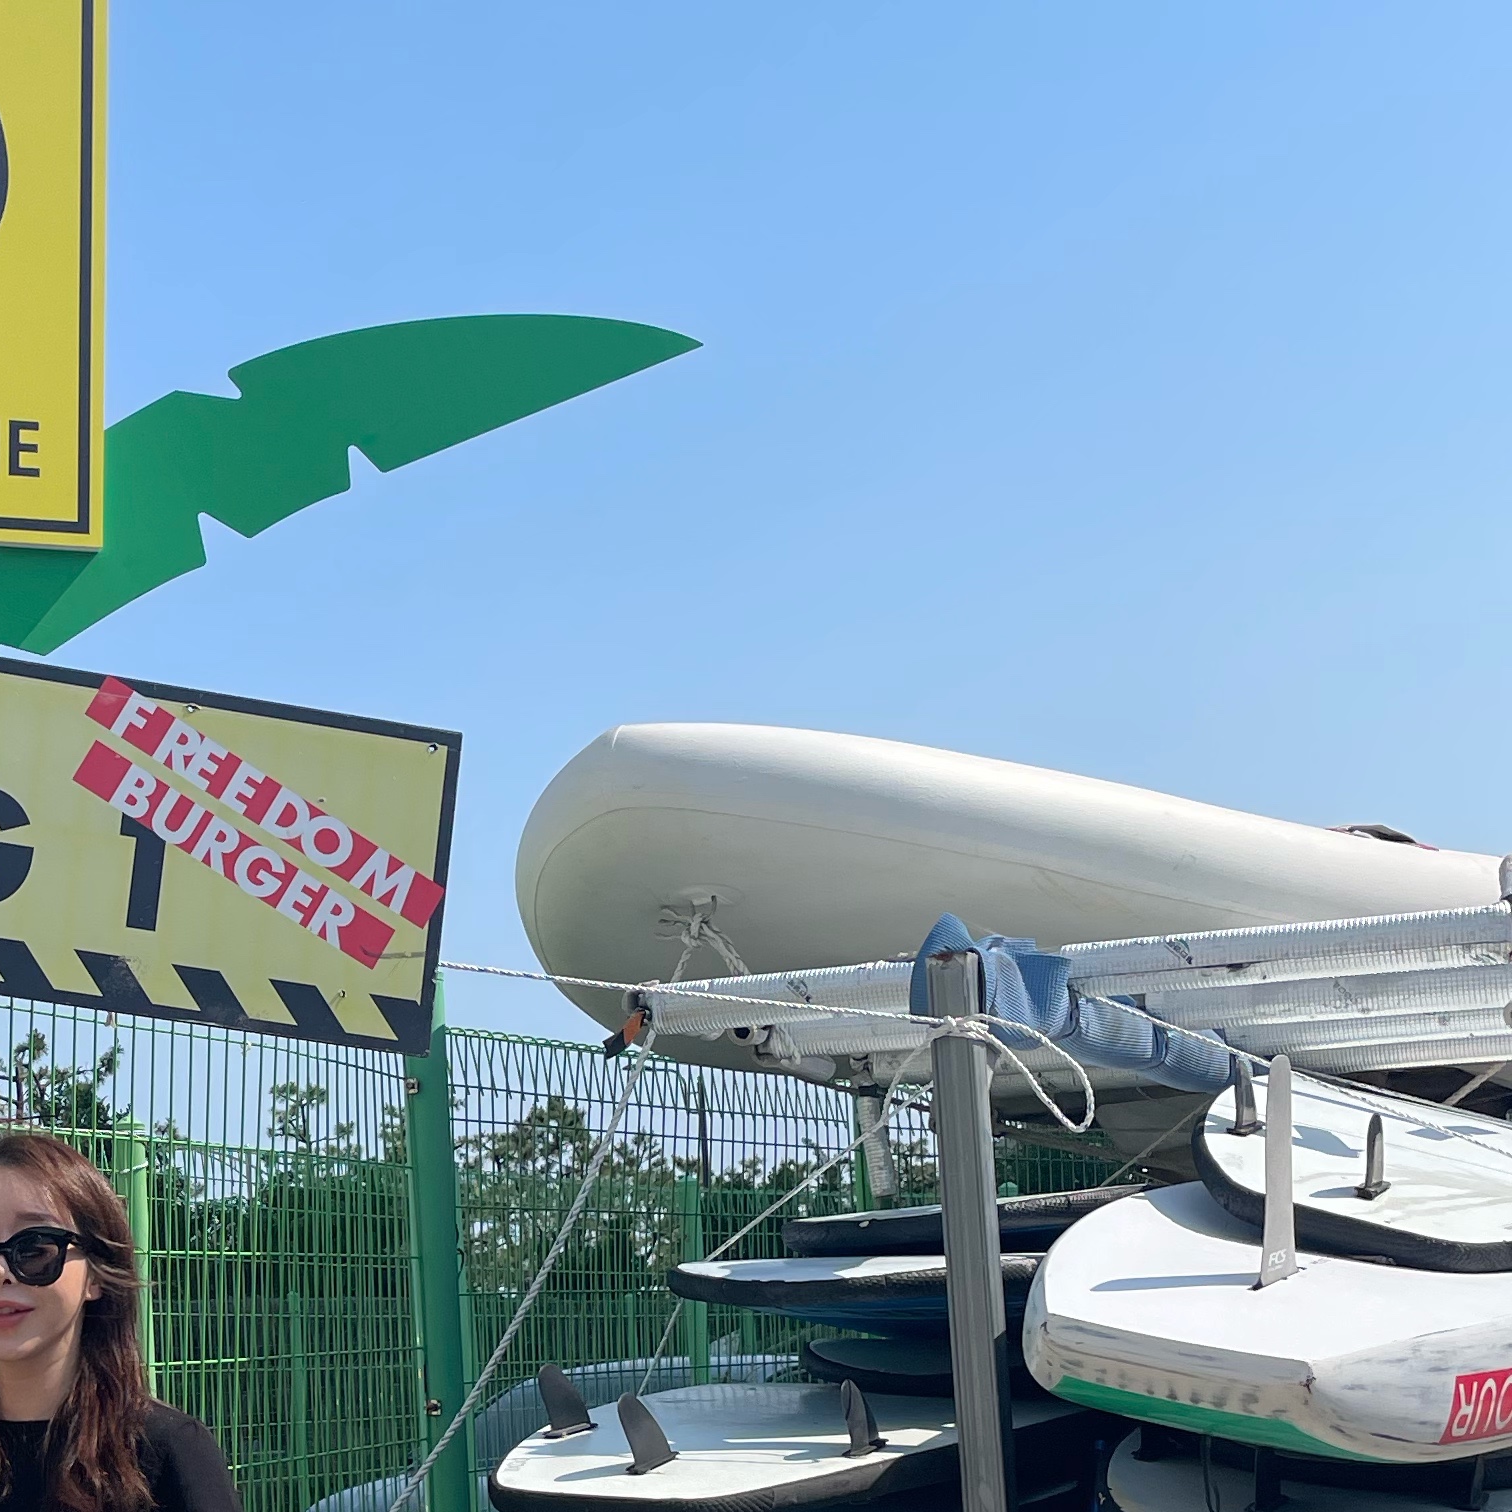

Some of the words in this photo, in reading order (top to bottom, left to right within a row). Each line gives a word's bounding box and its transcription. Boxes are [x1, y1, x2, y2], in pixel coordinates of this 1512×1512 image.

[108, 761, 356, 951] BURGER
[109, 690, 416, 915] FREEDOM
[119, 811, 167, 932] 1
[1268, 1248, 1287, 1267] FCS
